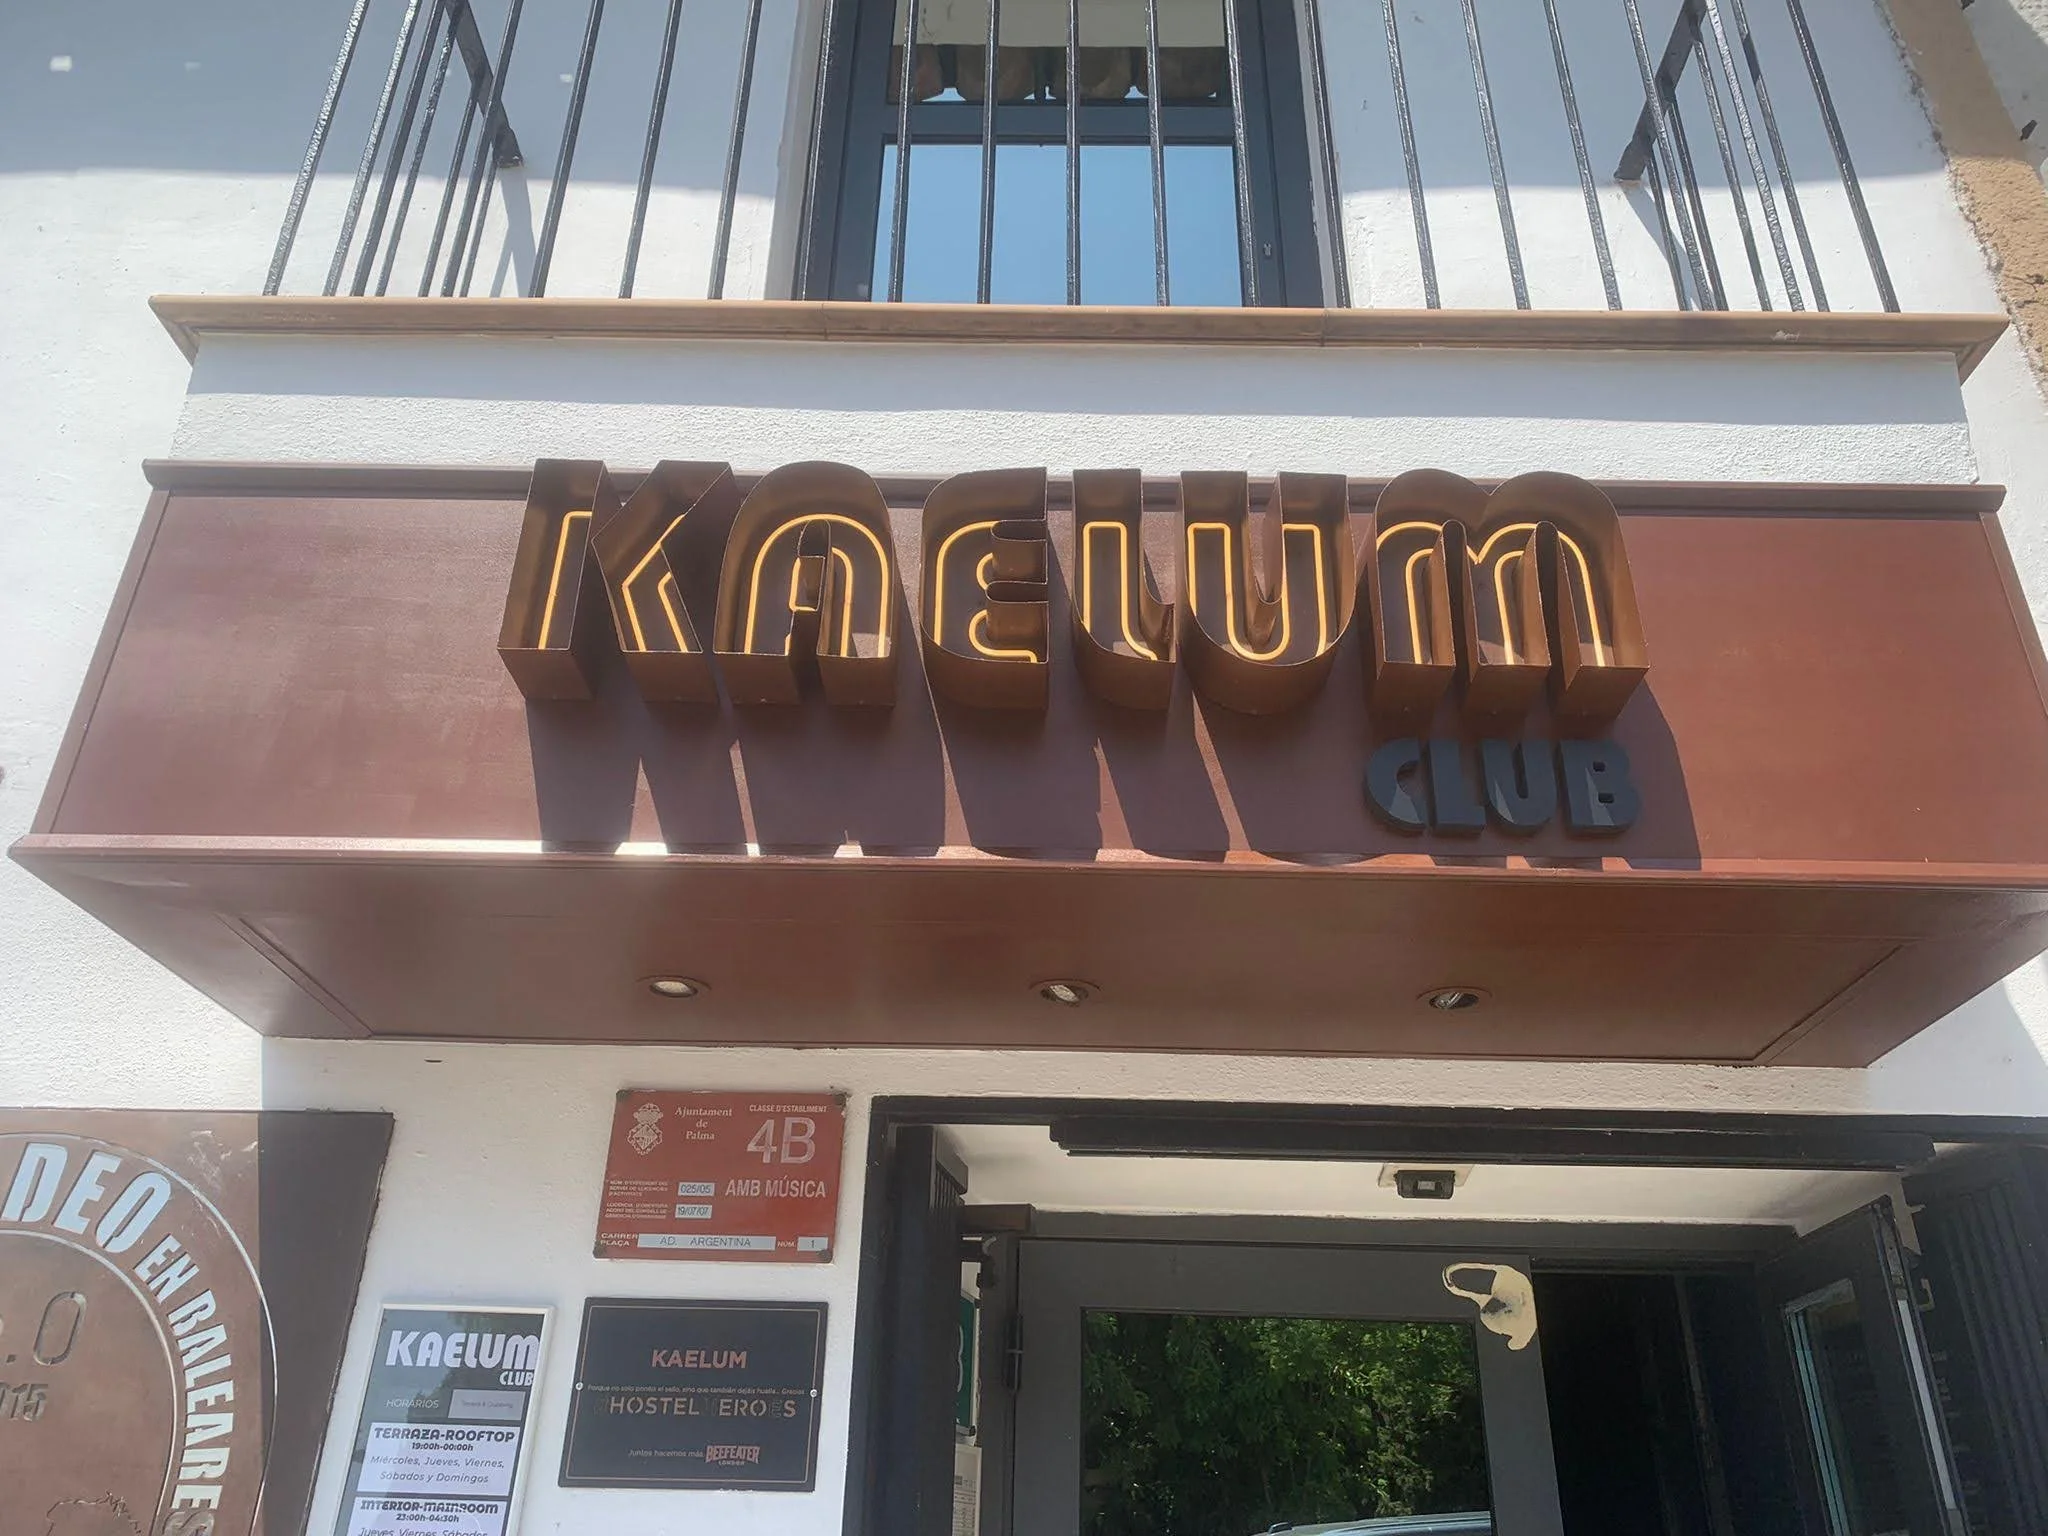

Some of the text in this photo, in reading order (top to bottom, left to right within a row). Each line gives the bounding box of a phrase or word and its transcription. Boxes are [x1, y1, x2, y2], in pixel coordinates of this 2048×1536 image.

[497, 460, 1650, 717] KAELUM
[1362, 737, 1643, 837] CLUB
[674, 1106, 733, 1117] Ajuntament
[749, 1104, 774, 1112] CLASSE
[695, 1118, 709, 1128] de
[685, 1130, 716, 1141] Palma
[746, 1116, 817, 1164] 4B
[725, 1175, 826, 1198] AMB MÚSICA
[601, 1232, 638, 1240] CARRER
[690, 1236, 751, 1247] ARGENTINA
[133, 1233, 200, 1304] EN
[385, 1330, 541, 1370] KAELUM
[652, 1349, 747, 1368] KAELUM
[499, 1369, 534, 1386] CLUB
[162, 1288, 234, 1536] BALEARES
[385, 1399, 440, 1410] HORARIOS
[610, 1396, 700, 1415] HOSTEL
[374, 1427, 515, 1443] TERRAZA-ROOFTOP
[411, 1442, 474, 1451] 19:00h-00:00h
[423, 1456, 461, 1467] Jueves,
[464, 1458, 505, 1469] Viernes,
[705, 1445, 760, 1465] BEEFEATER
[426, 1473, 434, 1483] y
[436, 1473, 489, 1485] Domingos
